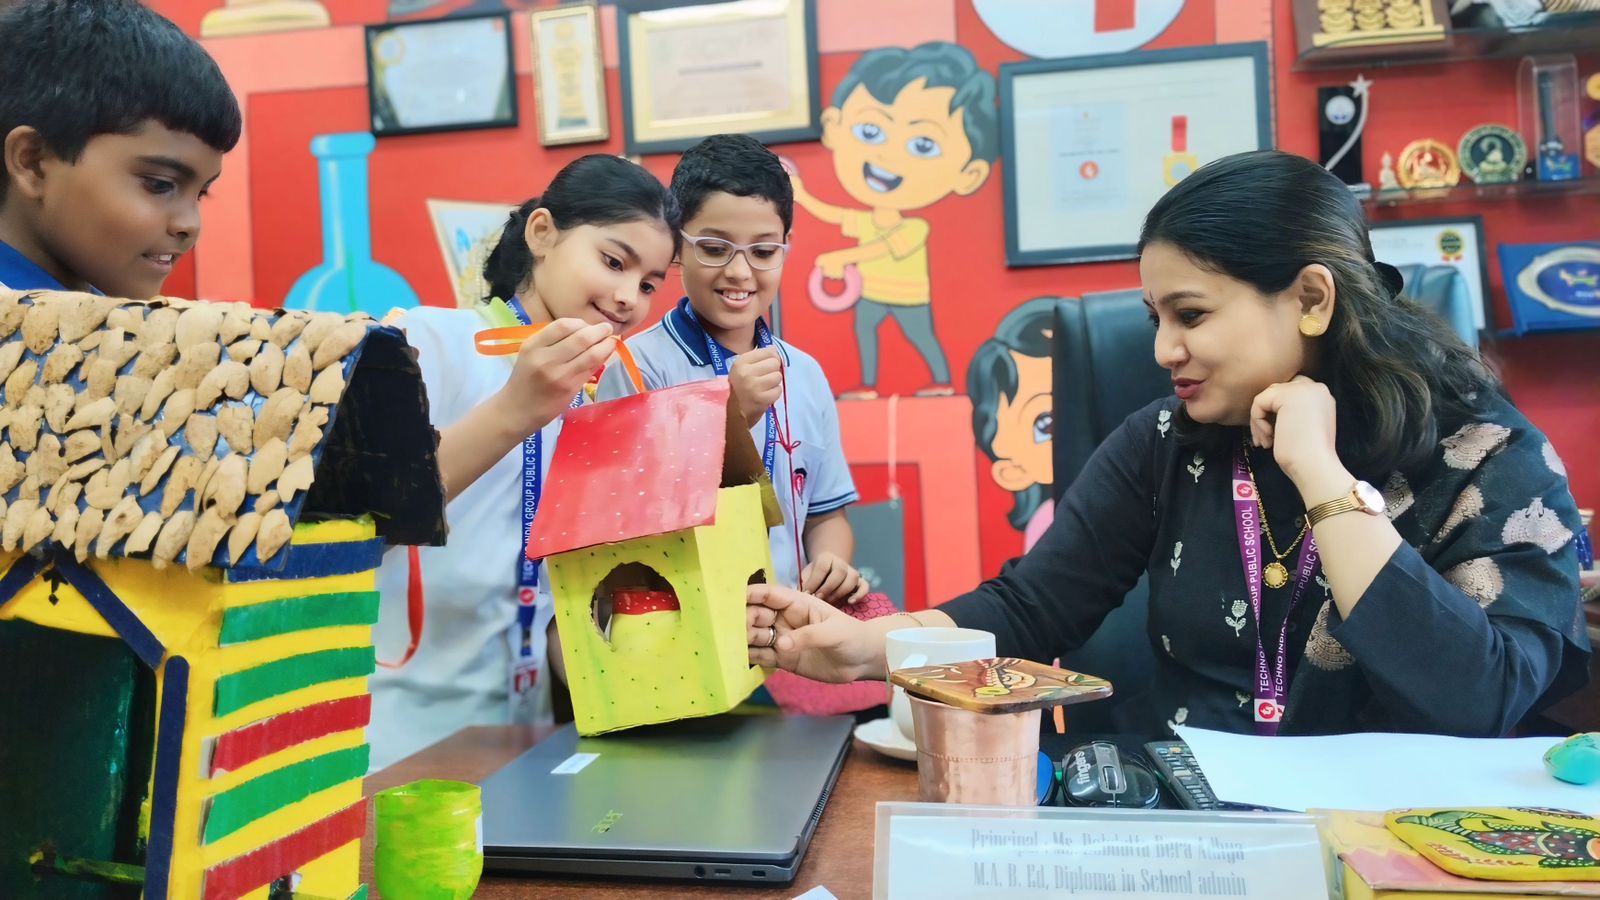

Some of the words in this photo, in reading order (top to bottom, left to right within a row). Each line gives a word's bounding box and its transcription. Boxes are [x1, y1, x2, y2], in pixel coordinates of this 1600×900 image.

[710, 344, 723, 371] TECHNO
[766, 441, 774, 466] PUBLI
[526, 456, 536, 487] PUBLIC
[525, 490, 535, 520] GROUP
[1241, 506, 1255, 546] SCHOOL
[1246, 548, 1258, 583] PUBLIC
[1299, 553, 1317, 589] PUBLIC
[1278, 626, 1286, 654] INDIA
[1260, 651, 1269, 692] TECHNO
[1274, 655, 1283, 697] TECHNO
[1074, 750, 1092, 785] fingers
[974, 862, 1002, 888] M.A.
[1008, 863, 1022, 888] B.
[1054, 865, 1116, 895] Diploma
[1121, 867, 1136, 893] in
[1141, 868, 1193, 895] School
[1198, 871, 1247, 897] admin
